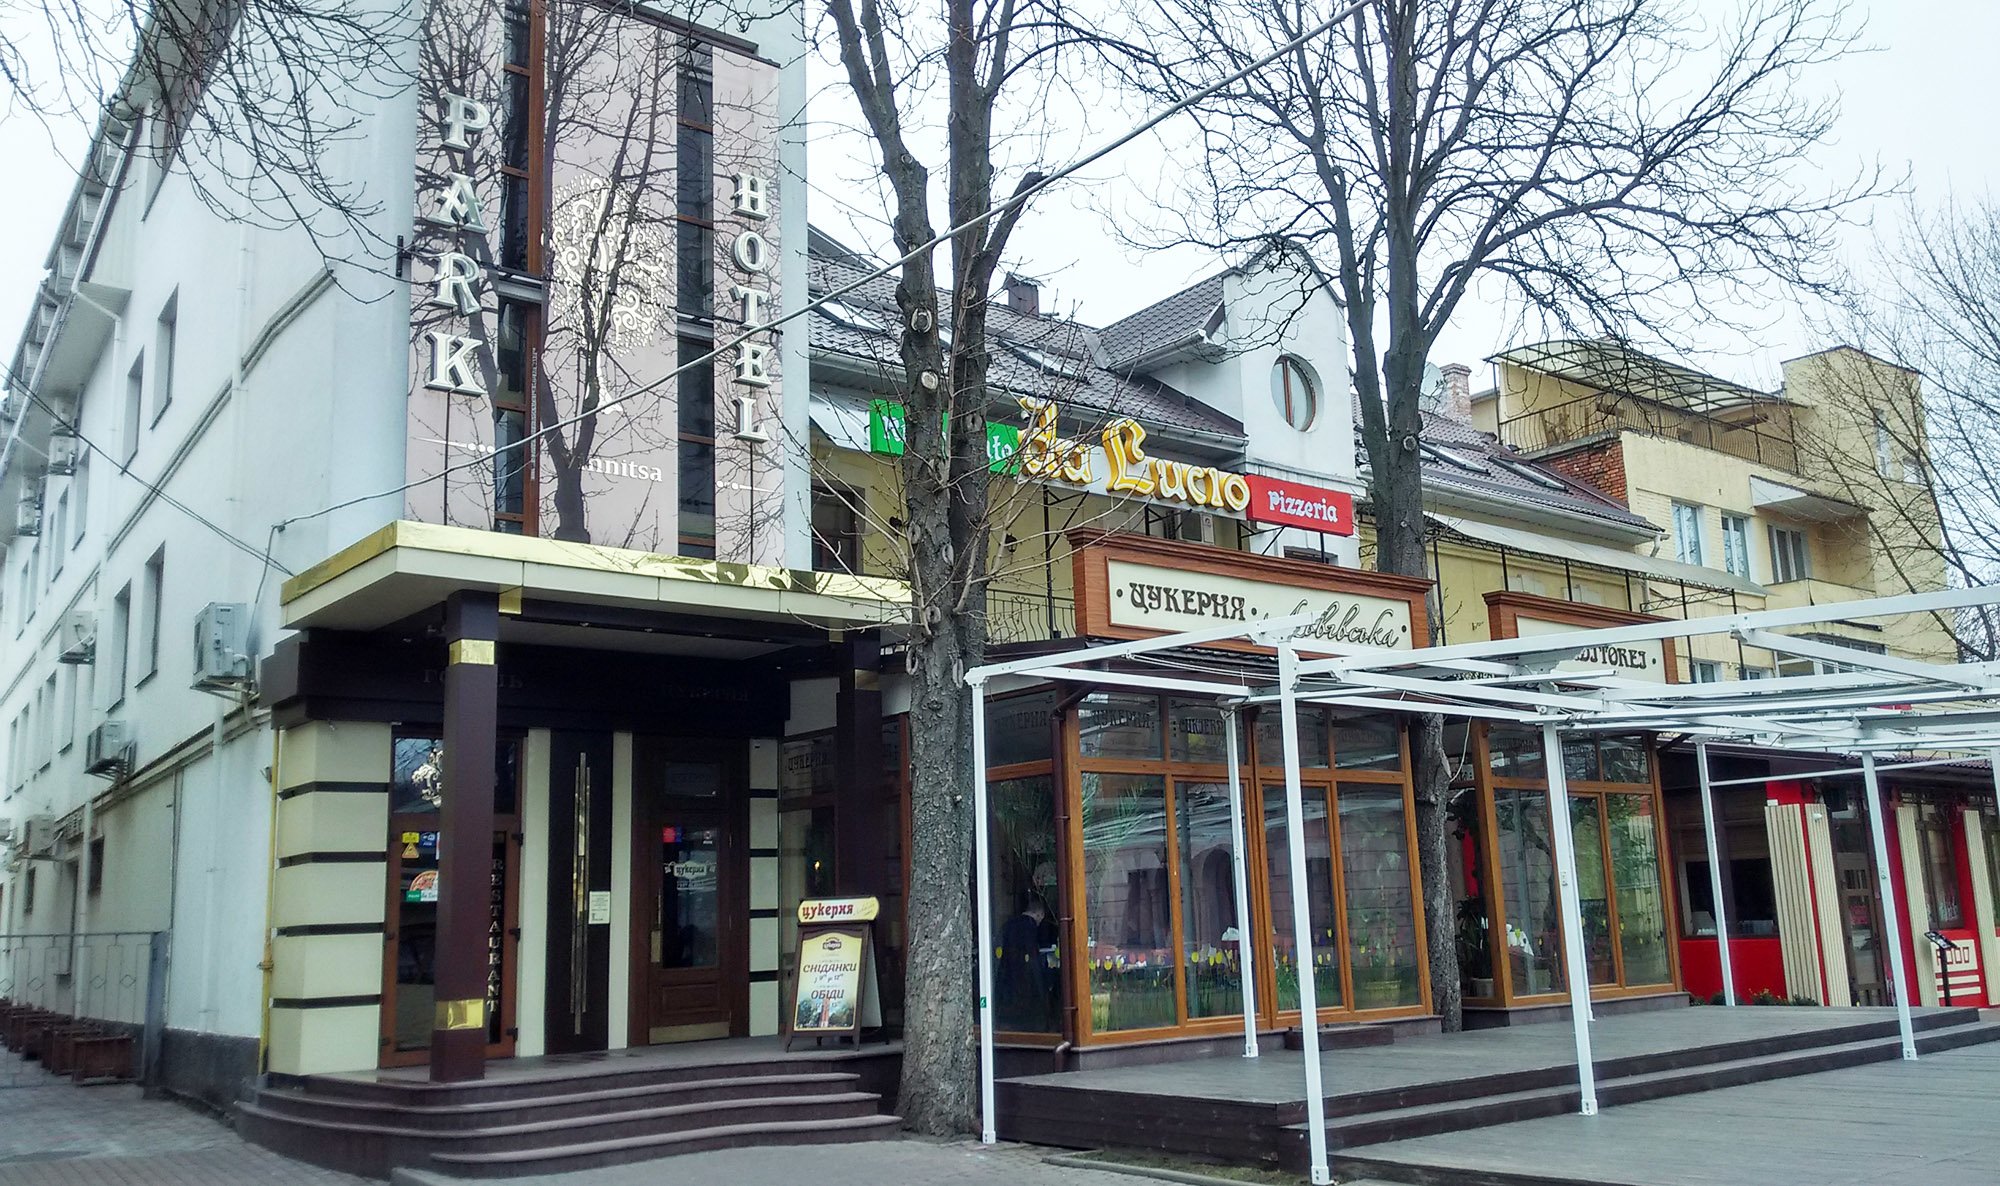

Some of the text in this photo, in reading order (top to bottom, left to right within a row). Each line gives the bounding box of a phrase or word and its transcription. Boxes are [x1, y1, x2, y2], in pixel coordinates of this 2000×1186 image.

[422, 93, 489, 396] PARK
[727, 172, 772, 443] HOTEL
[581, 458, 663, 482] nnitsa
[1267, 489, 1338, 523] Pizzeria
[1129, 582, 1246, 621] ЦУКЕРНЯ
[802, 903, 854, 919] цукерня
[486, 858, 503, 1013] RESTAURANT
[803, 962, 857, 974] СНІДАНКИ
[811, 989, 844, 1000] ОБІДИ
